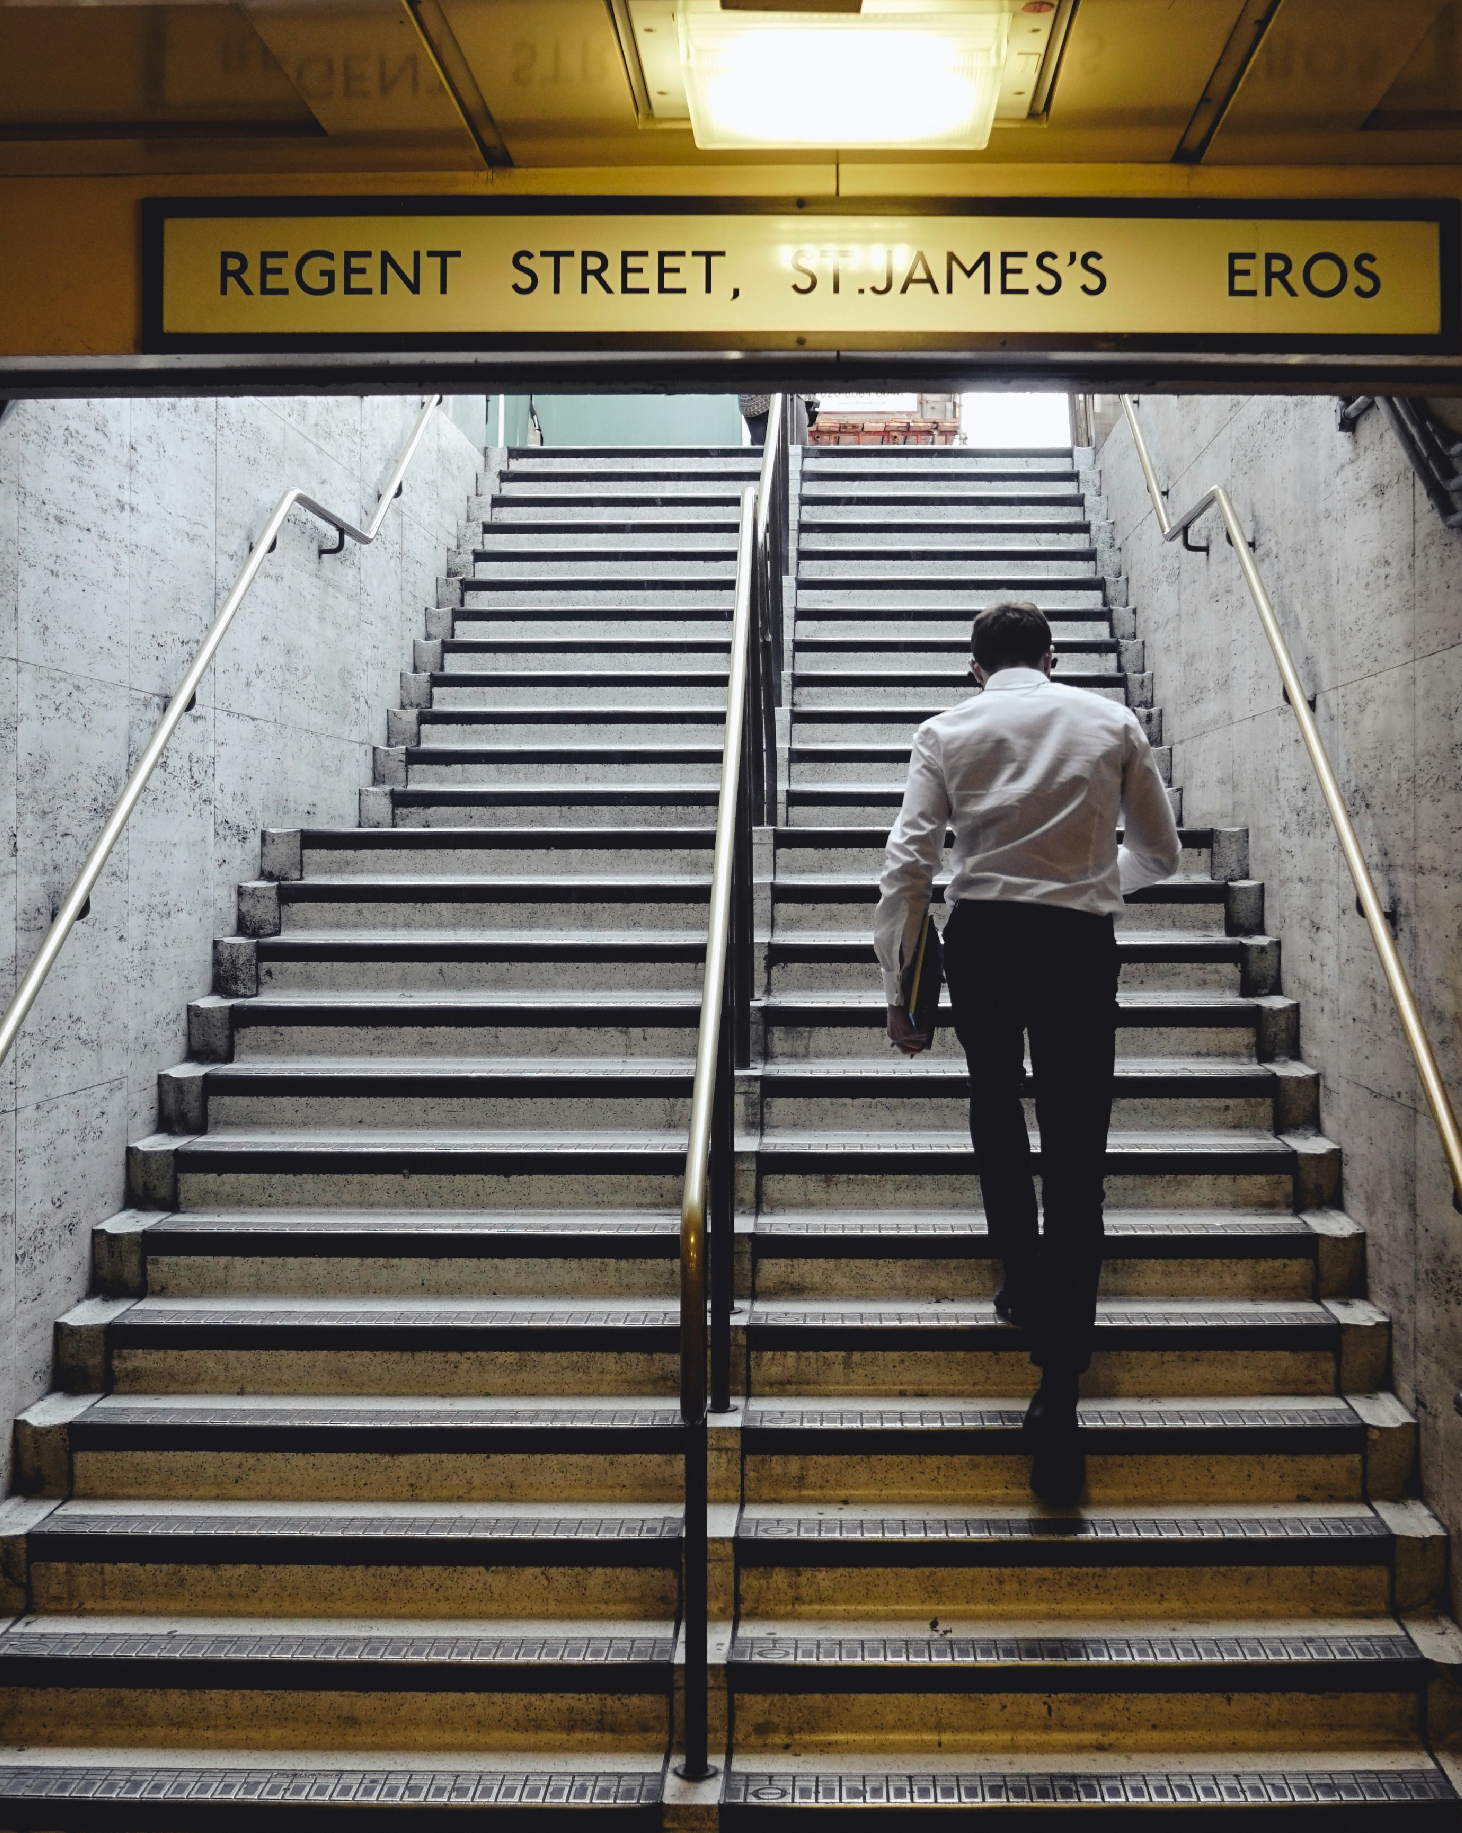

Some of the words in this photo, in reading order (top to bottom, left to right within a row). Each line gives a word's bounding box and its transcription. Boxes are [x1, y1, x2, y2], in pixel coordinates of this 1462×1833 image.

[220, 249, 462, 297] REGENT
[511, 249, 740, 300] STREET,
[1227, 251, 1382, 299] EROS
